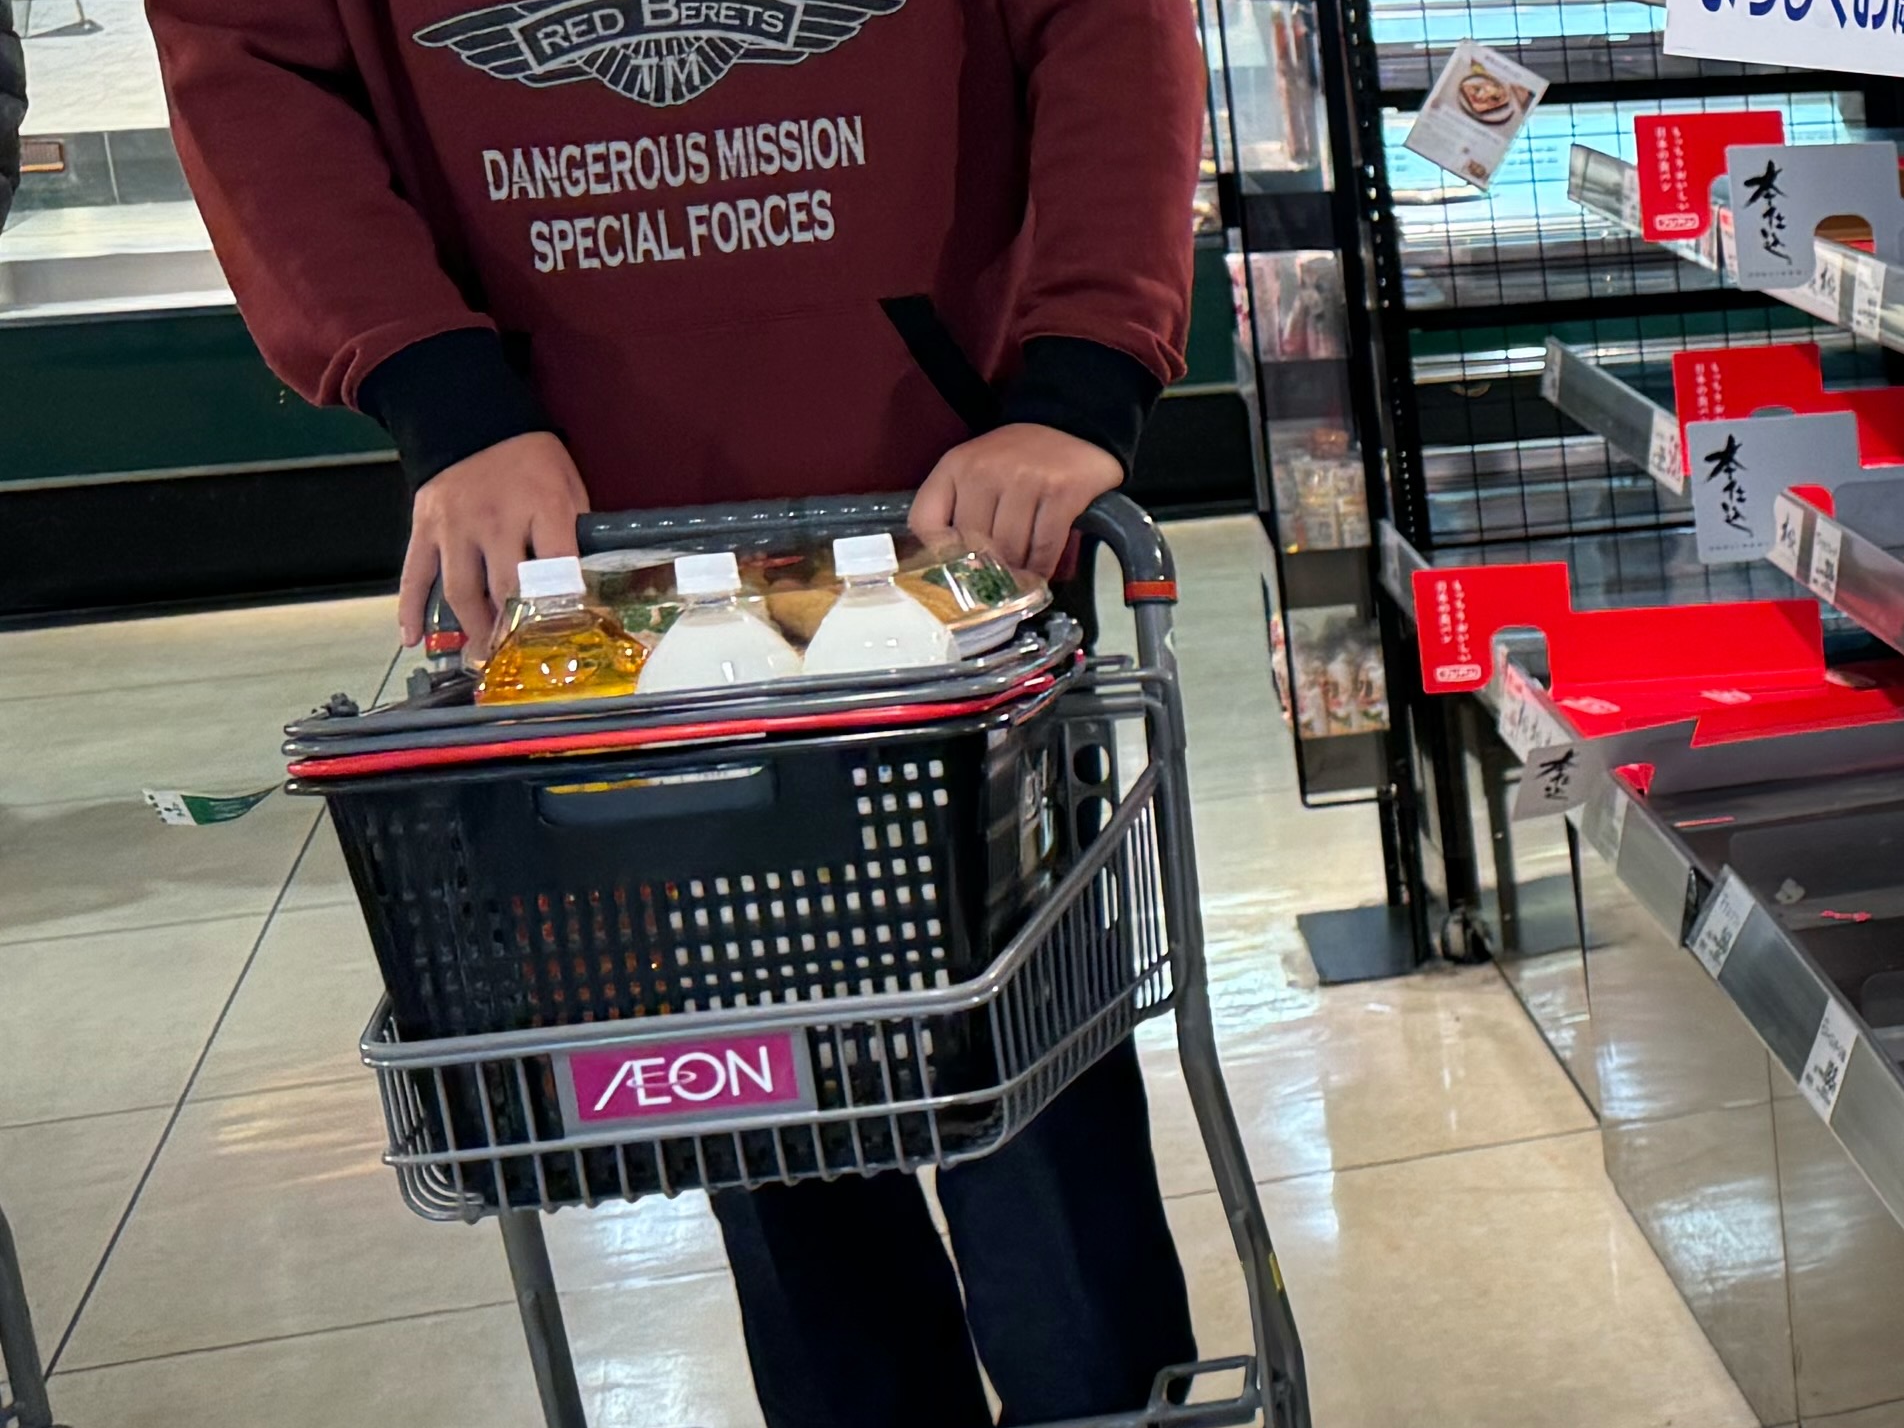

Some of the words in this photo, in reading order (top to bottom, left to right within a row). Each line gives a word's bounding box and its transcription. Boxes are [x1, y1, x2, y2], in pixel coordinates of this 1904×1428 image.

[534, 9, 623, 52] RED
[483, 131, 709, 202] DANGEROUS
[717, 116, 865, 181] MISSION
[530, 208, 684, 274] SPECIAL
[692, 193, 834, 253] FORCES
[1743, 159, 1792, 265] 本仕込
[1703, 433, 1753, 538] 本仕込
